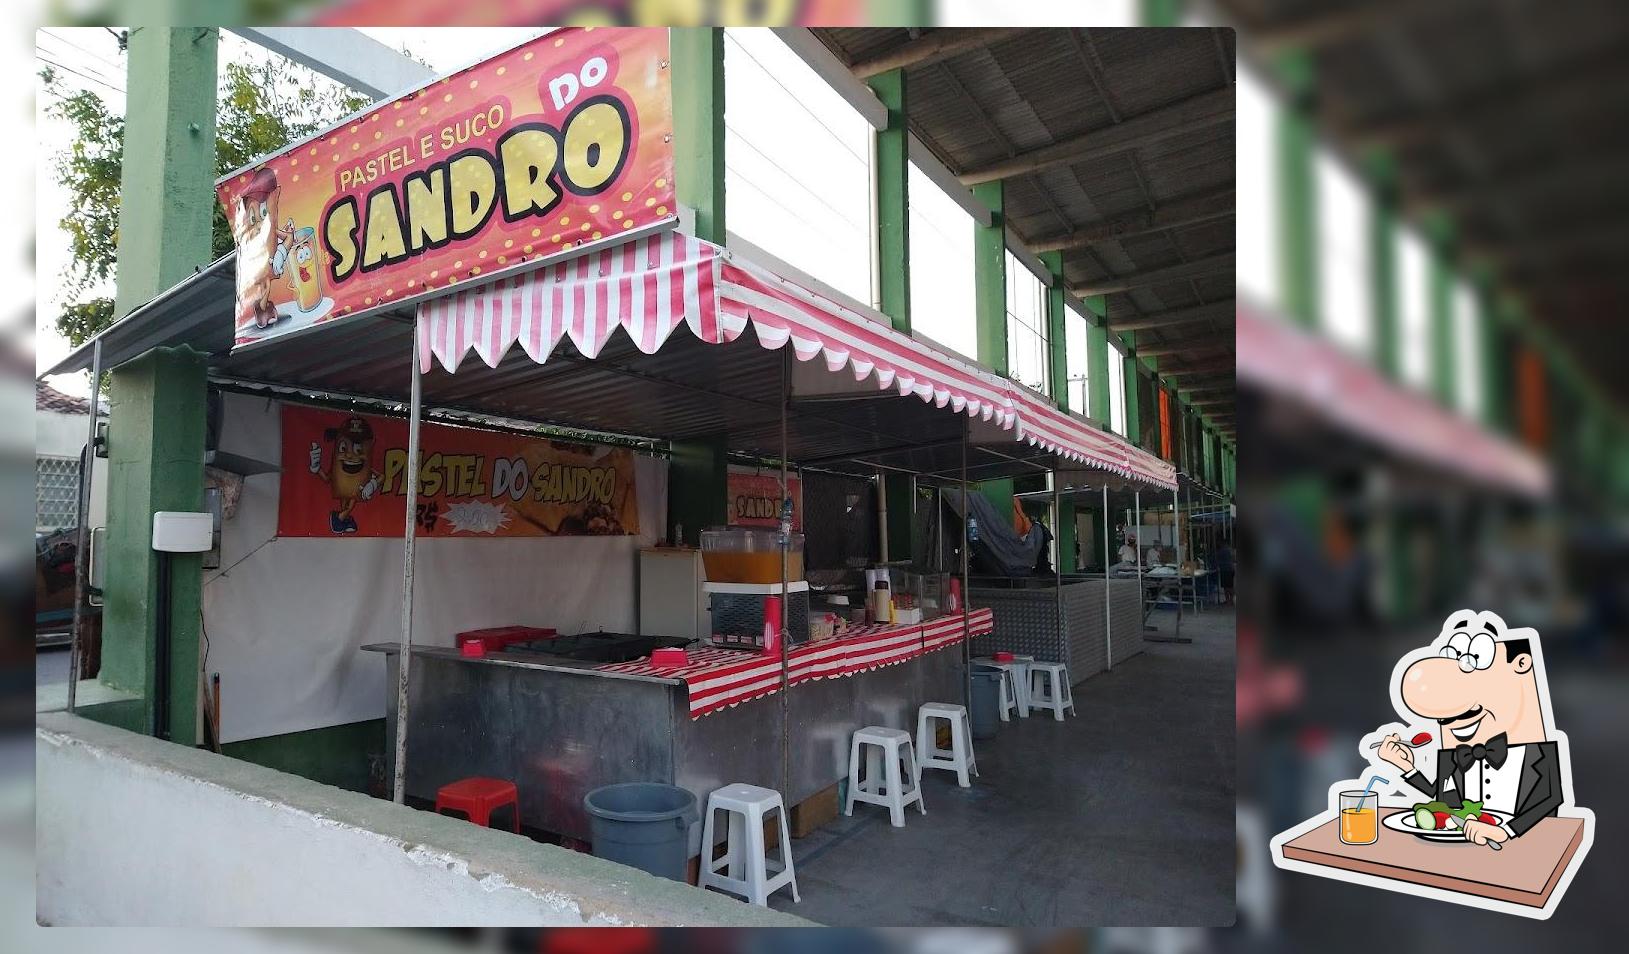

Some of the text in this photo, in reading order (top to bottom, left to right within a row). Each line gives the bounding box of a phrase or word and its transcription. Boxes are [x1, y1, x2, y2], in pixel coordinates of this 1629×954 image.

[548, 56, 608, 110] DO
[339, 104, 504, 192] PASTEL E SUCO
[324, 94, 632, 282] SANDRO
[491, 457, 529, 502] DO
[530, 462, 617, 505] SANDRO
[736, 495, 795, 519] SANDR
